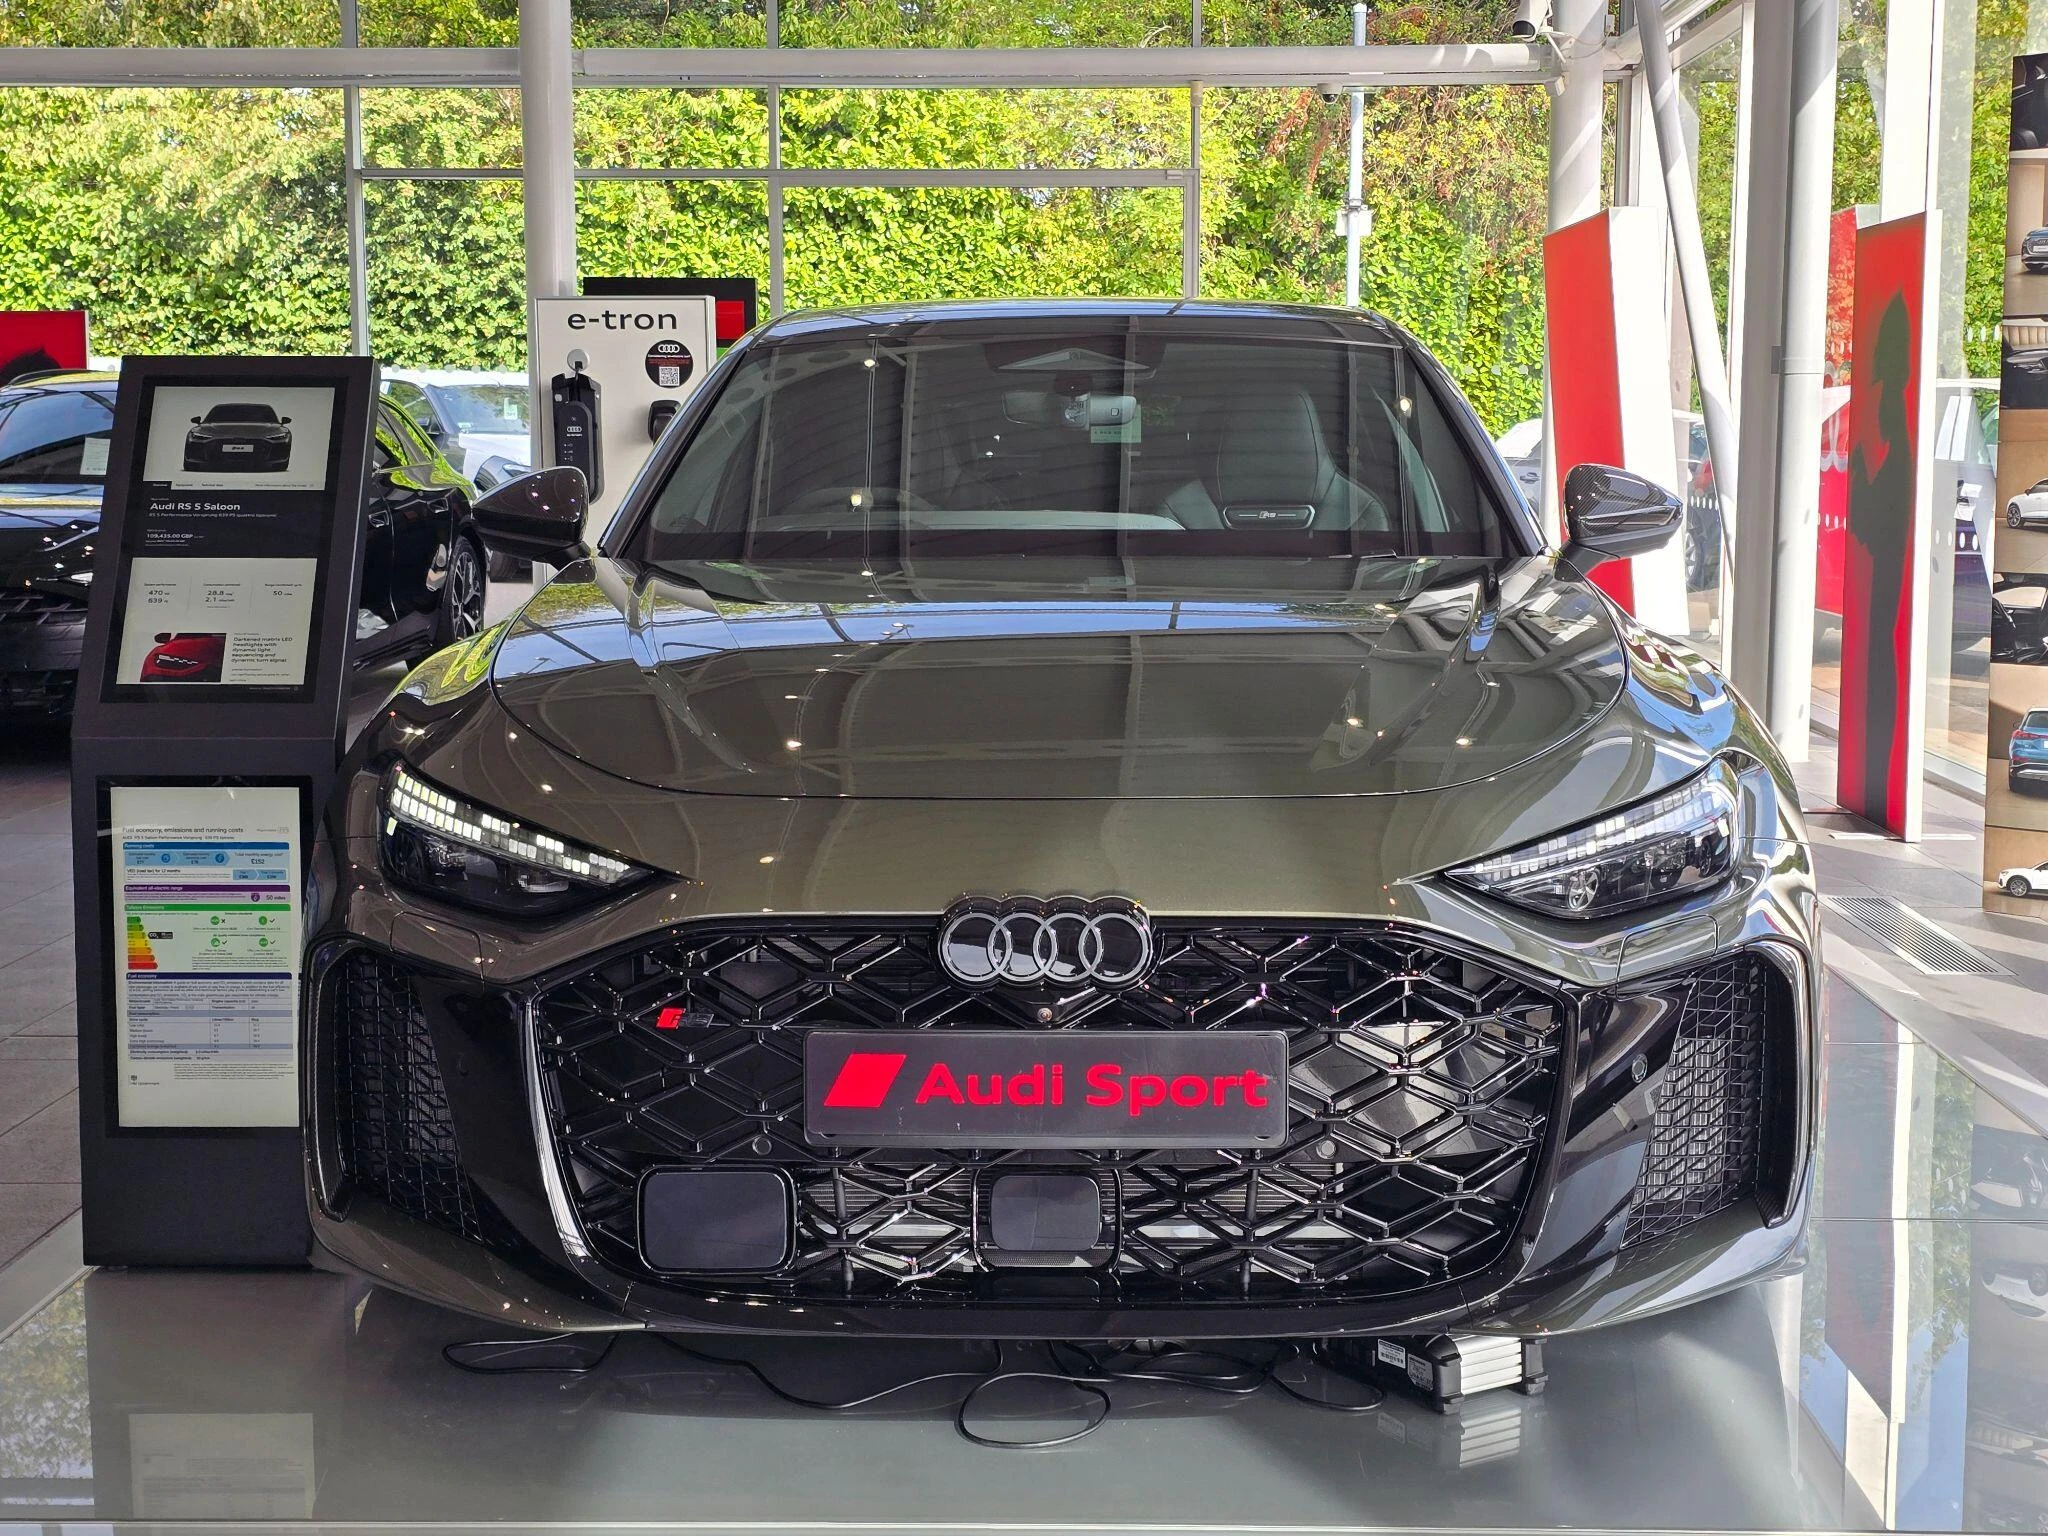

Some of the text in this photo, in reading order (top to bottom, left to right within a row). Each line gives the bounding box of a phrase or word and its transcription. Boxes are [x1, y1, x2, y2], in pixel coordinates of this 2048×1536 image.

[567, 310, 677, 330] e-tron
[150, 502, 175, 511] Audi
[177, 502, 192, 511] RS
[204, 502, 241, 511] Saloon
[205, 827, 227, 835] running
[915, 1063, 1268, 1117] Audi Sport
